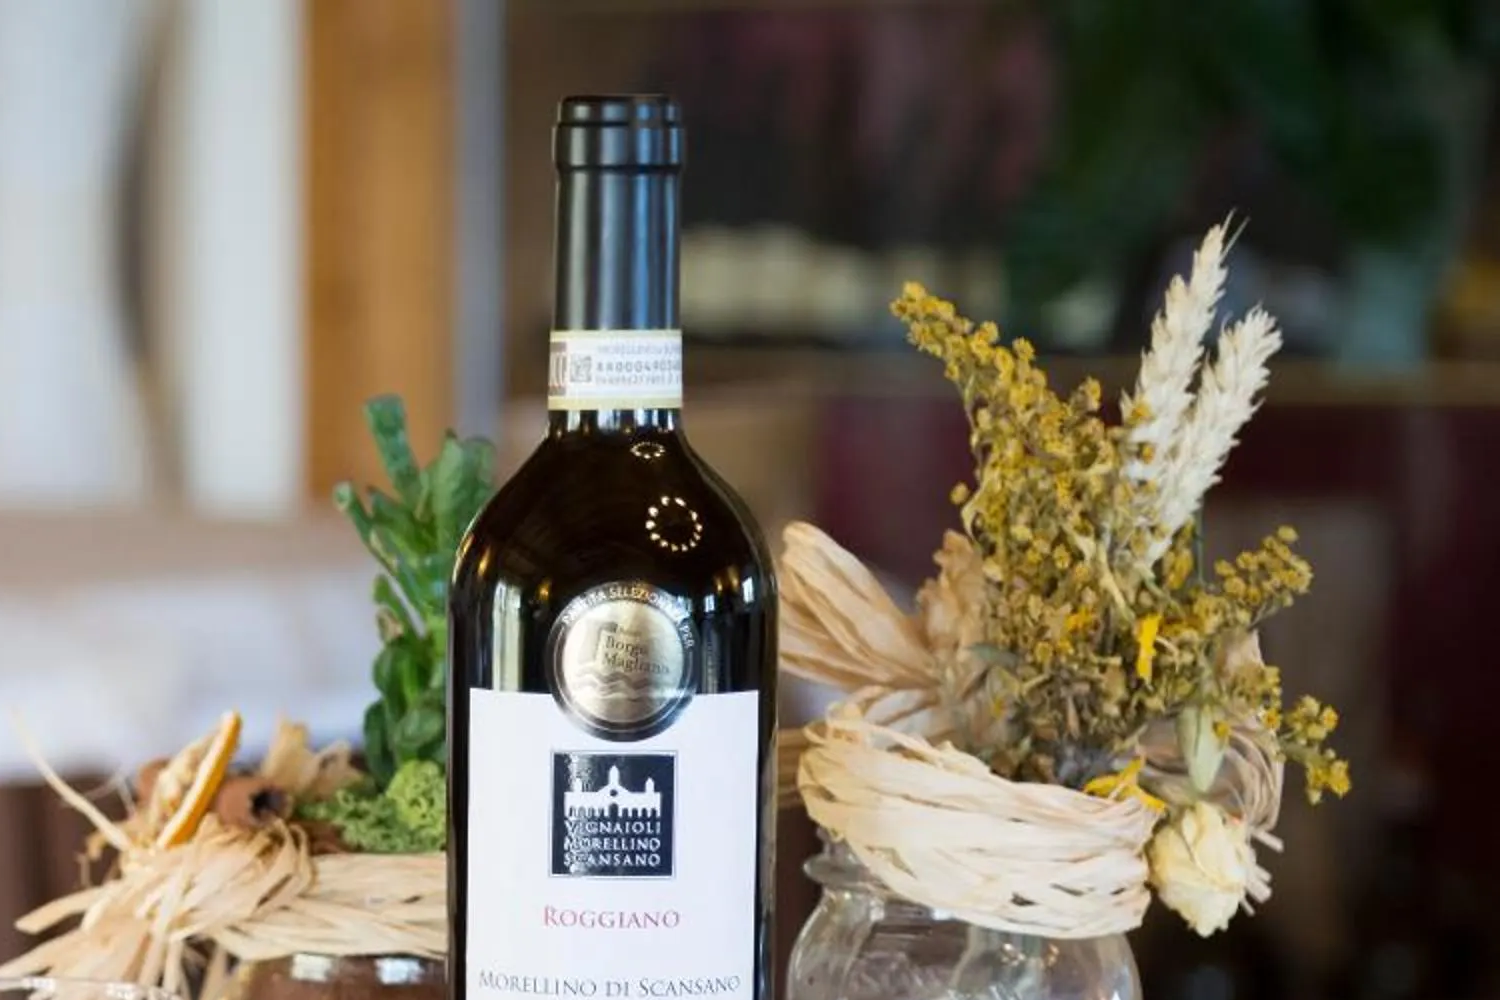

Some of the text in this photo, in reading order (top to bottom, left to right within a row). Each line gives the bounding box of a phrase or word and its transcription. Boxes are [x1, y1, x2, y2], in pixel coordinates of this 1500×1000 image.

[565, 820, 661, 834] VIGNAIOLI
[564, 838, 661, 850] MORELLINO
[564, 853, 661, 866] SCANSANO
[543, 905, 680, 928] ROGGIANO
[479, 970, 741, 998] MORELLINO DI SCANSANO
